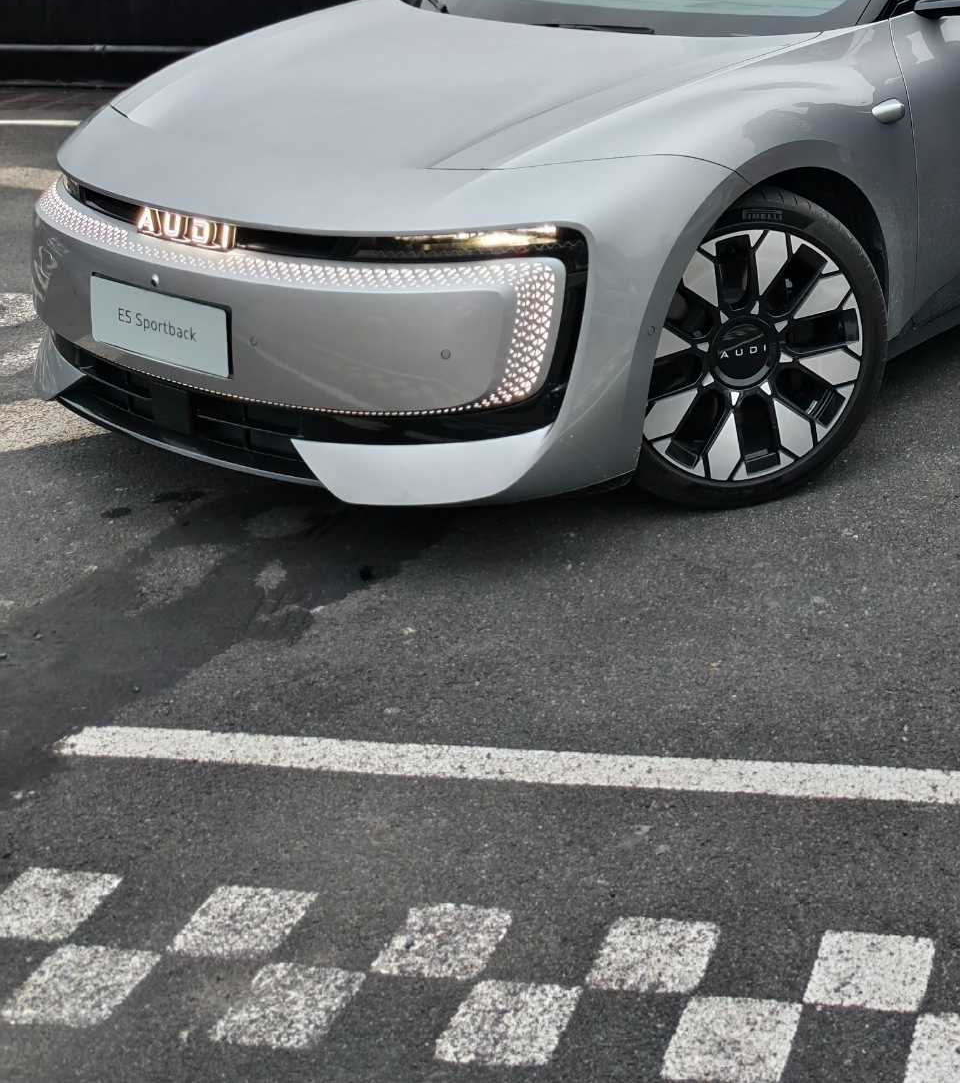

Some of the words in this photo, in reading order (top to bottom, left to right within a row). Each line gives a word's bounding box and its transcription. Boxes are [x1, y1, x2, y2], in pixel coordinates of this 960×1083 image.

[137, 205, 237, 250] AUDI
[118, 307, 132, 324] E5
[135, 313, 197, 342] Sportback
[720, 344, 767, 359] AUDI
